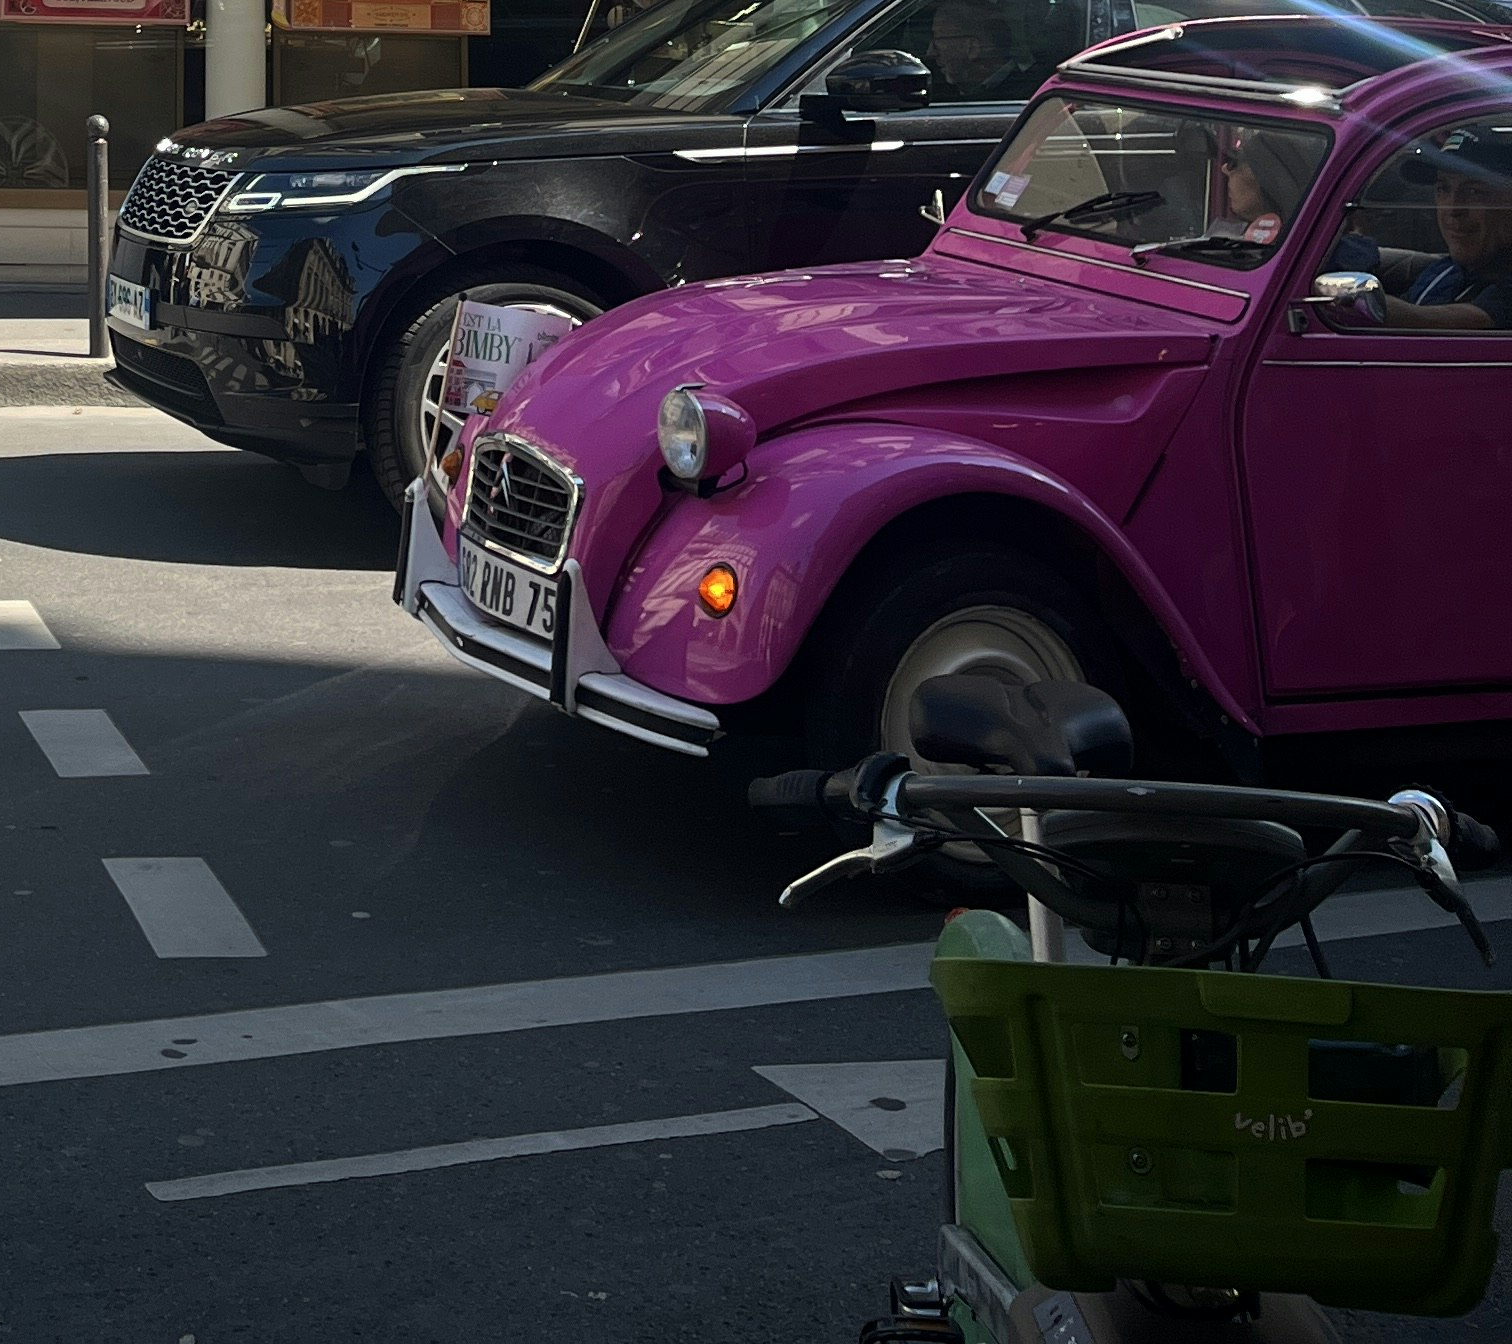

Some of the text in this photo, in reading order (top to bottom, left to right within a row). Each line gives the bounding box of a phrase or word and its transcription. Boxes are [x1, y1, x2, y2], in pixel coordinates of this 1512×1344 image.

[487, 315, 502, 333] LA
[479, 561, 516, 617] RNB
[526, 580, 557, 634] 75
